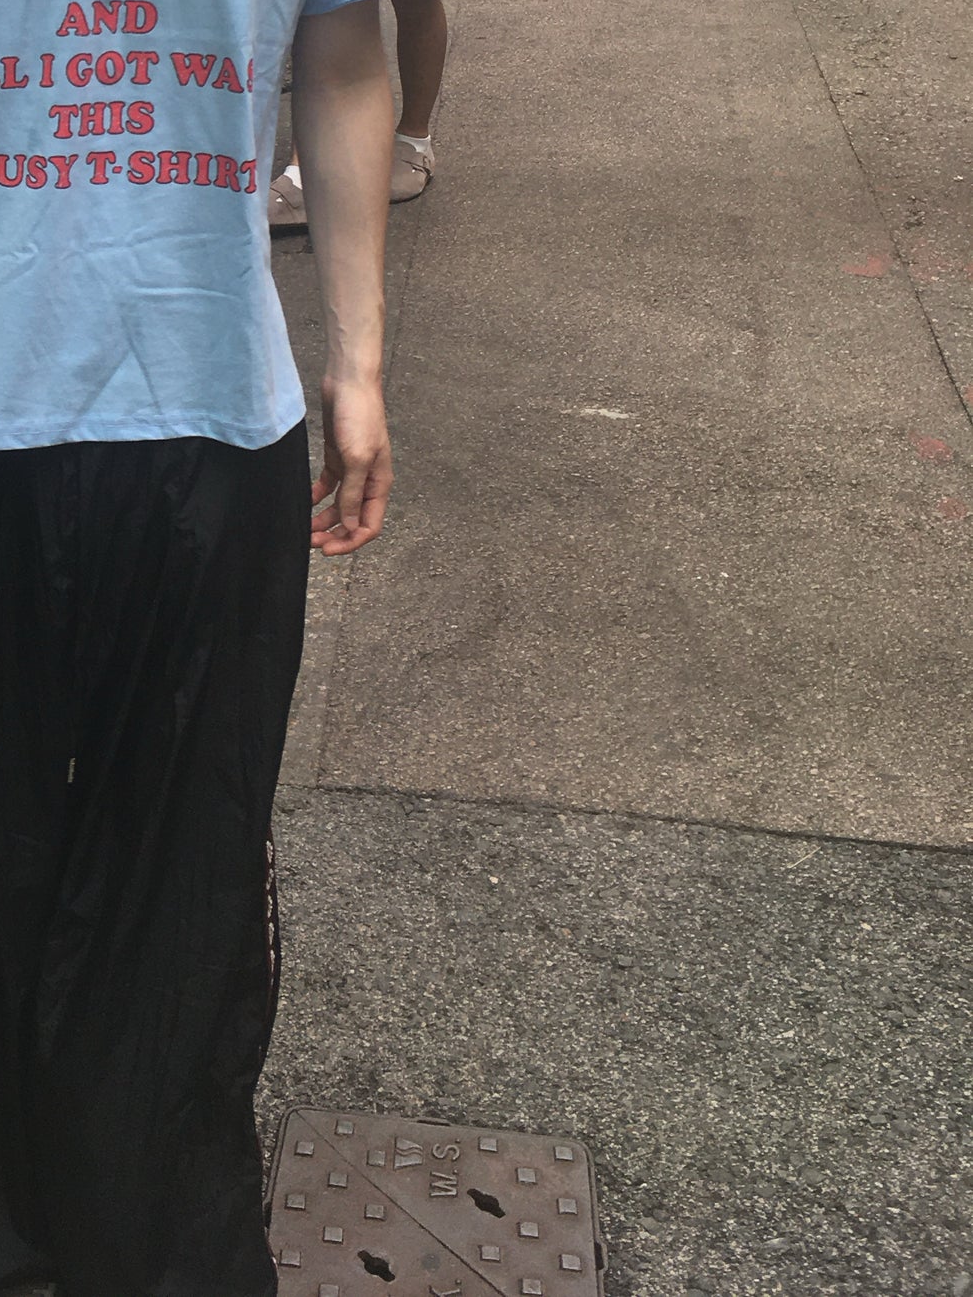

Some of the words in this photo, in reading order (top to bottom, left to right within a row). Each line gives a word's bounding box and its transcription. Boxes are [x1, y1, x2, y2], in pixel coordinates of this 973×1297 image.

[56, 0, 159, 37] AND
[39, 53, 55, 88] I
[65, 50, 160, 88] GOT
[169, 51, 254, 93] WA
[48, 100, 155, 140] THIS
[85, 149, 258, 194] T-SHIRT
